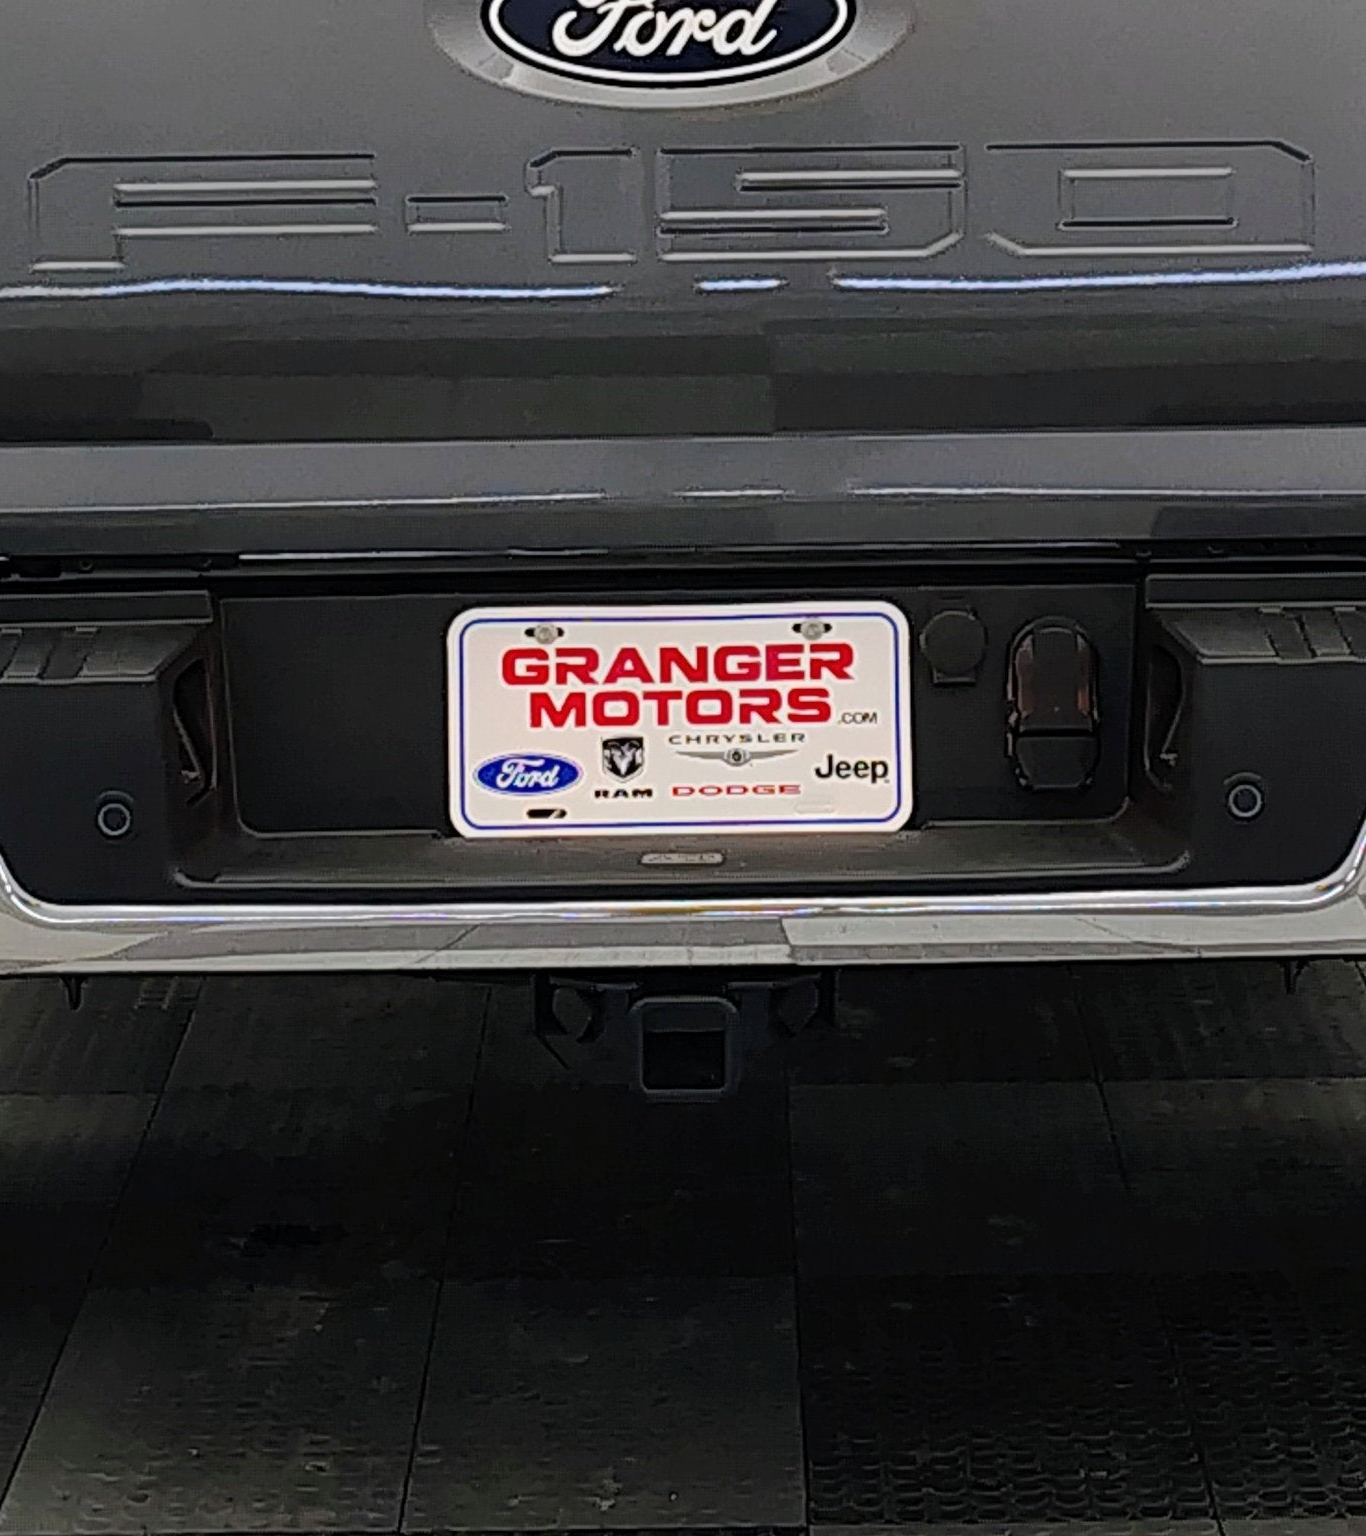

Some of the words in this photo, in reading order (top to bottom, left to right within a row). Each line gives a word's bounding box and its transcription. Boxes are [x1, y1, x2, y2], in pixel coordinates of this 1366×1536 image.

[28, 140, 1316, 273] F-150
[502, 643, 855, 686] GRANGER
[530, 687, 832, 727] MOTORS
[668, 732, 806, 745] CHRYSLER
[496, 758, 561, 790] Ford
[815, 754, 889, 784] Jeep
[594, 787, 654, 799] RAM
[671, 783, 802, 797] DODGE
